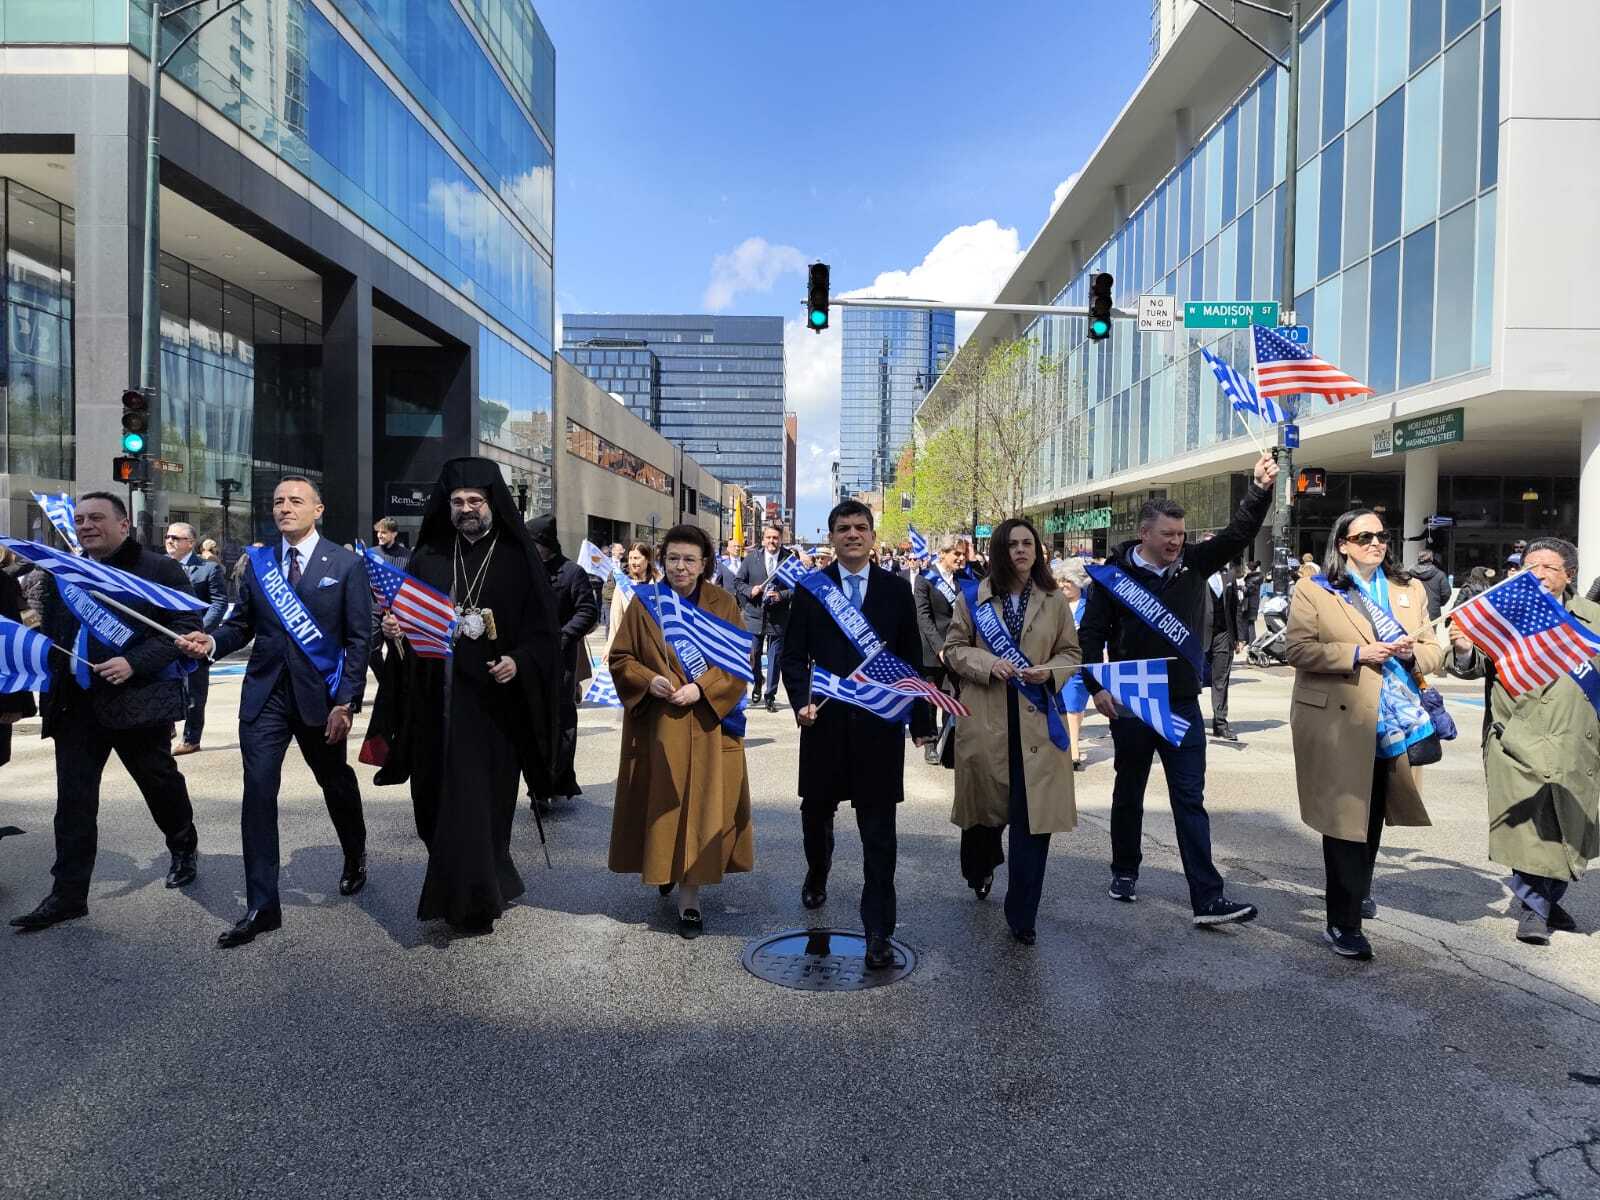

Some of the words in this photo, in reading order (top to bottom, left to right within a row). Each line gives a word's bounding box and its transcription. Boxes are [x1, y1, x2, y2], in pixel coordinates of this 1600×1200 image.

[1203, 305, 1254, 316] MADISON
[1262, 306, 1272, 314] ST
[1282, 330, 1298, 340] TO
[1416, 426, 1437, 438] PARKING
[1439, 414, 1455, 425] LEVEL
[1406, 434, 1438, 448] WASHINGTON
[1437, 430, 1456, 442] STREET
[88, 608, 105, 626] OF
[262, 567, 324, 645] PRESIDENT
[1113, 577, 1167, 623] HONORARY
[1158, 612, 1190, 646] GUEST
[94, 613, 134, 648] EDUCATION
[838, 606, 870, 640] GENERAL
[858, 631, 876, 647] OF
[976, 602, 1001, 642] CONSUL
[992, 635, 1010, 653] OF
[680, 644, 709, 681] CULTUR
